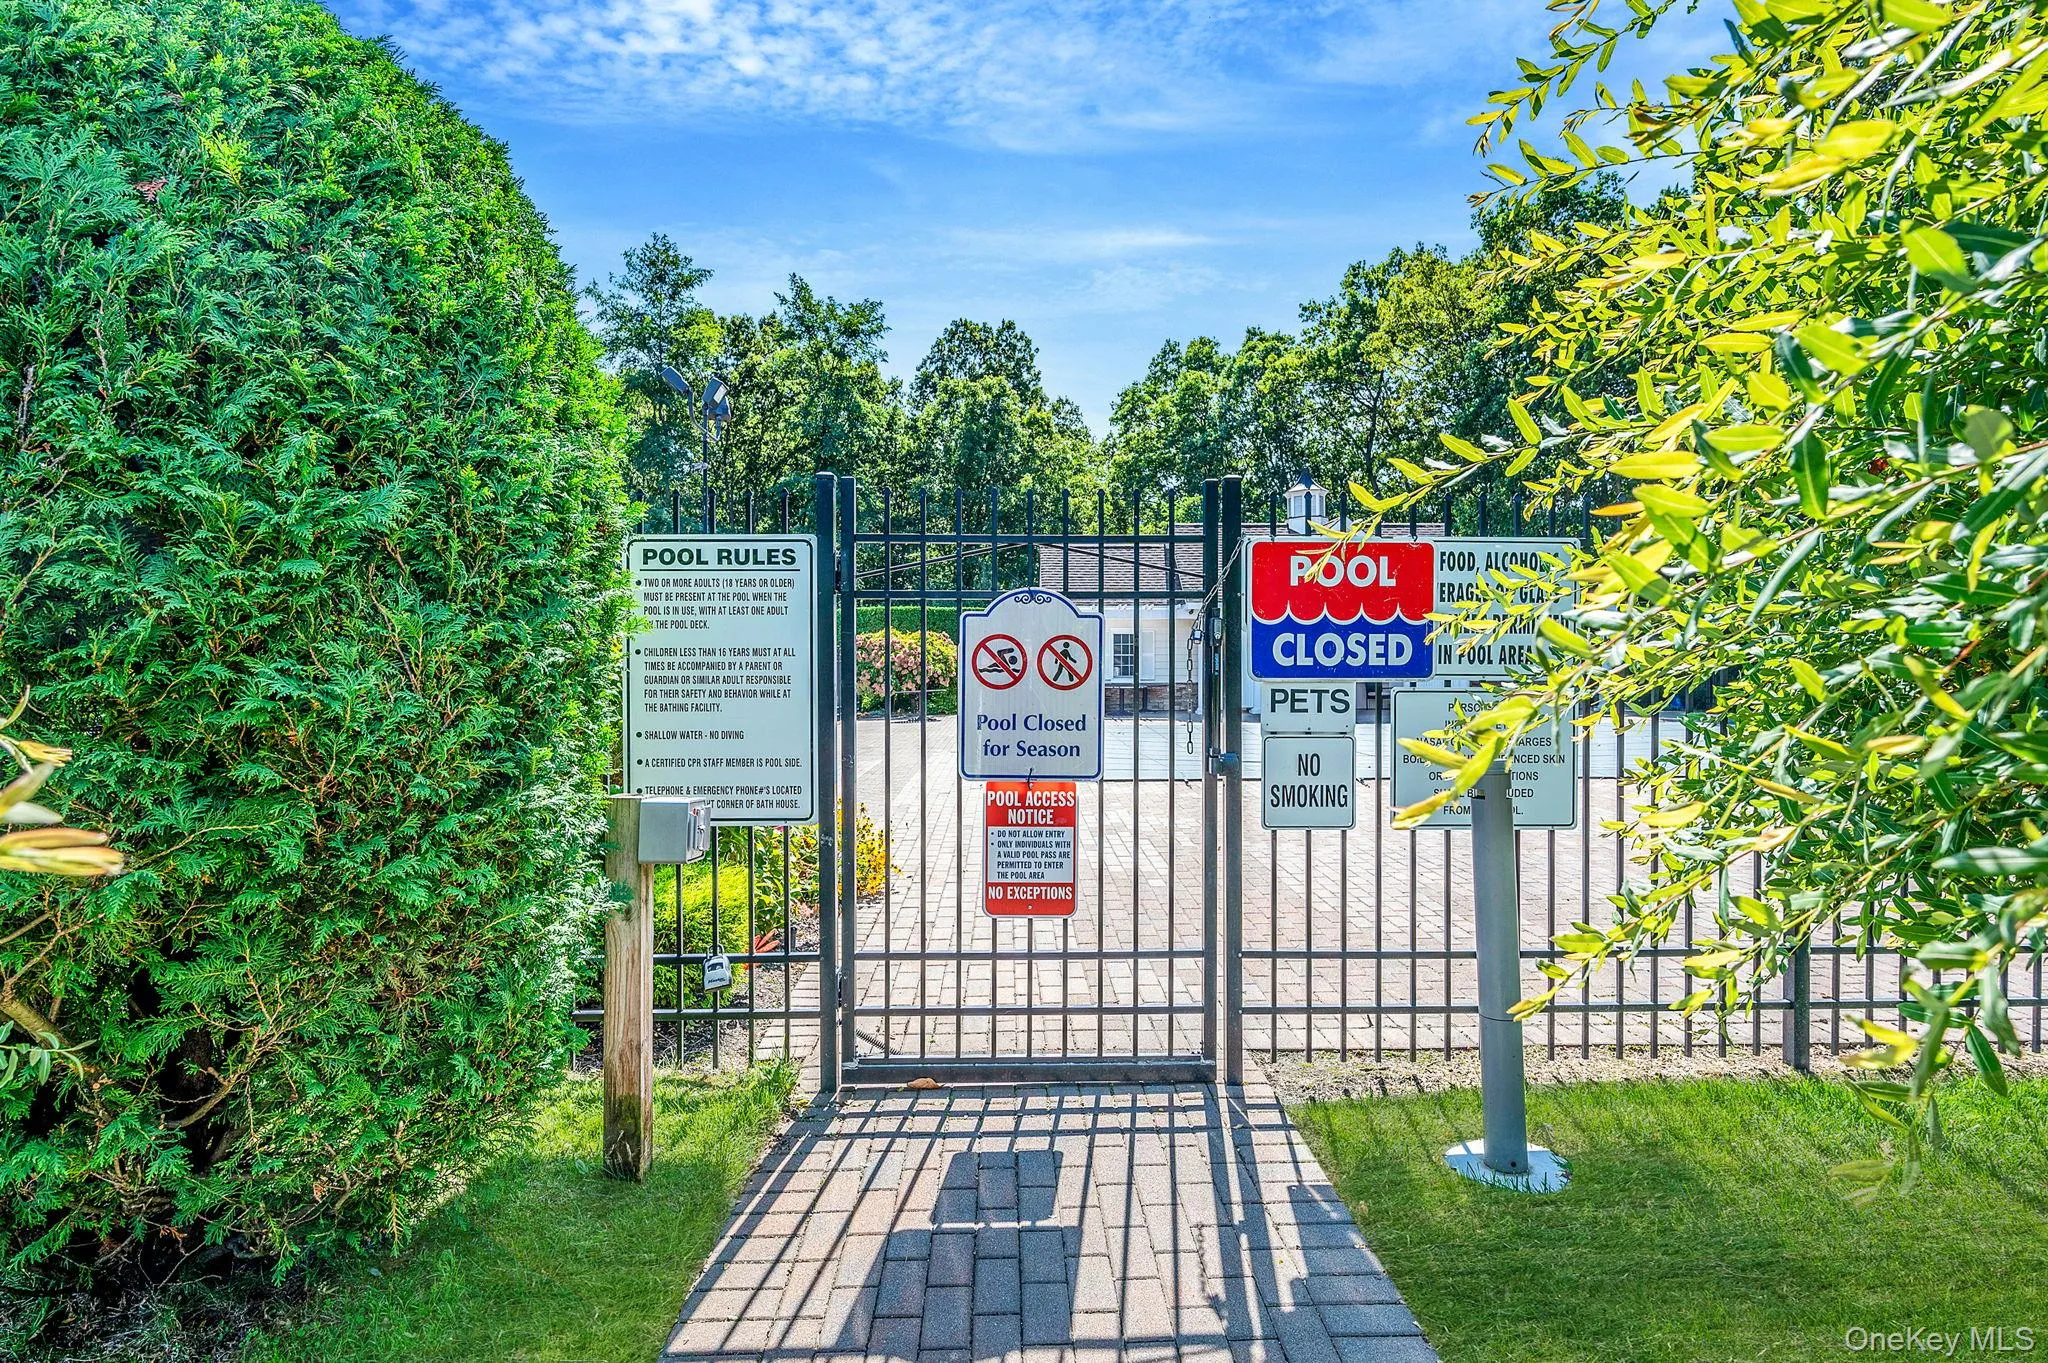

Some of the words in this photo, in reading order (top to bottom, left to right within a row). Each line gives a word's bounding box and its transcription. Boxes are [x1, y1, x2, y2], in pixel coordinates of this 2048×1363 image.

[642, 548, 709, 566] POOL
[717, 548, 796, 566] RULES
[1440, 551, 1480, 576] FOOD,
[1485, 552, 1560, 573] ALCOHOL
[1290, 555, 1397, 587] POOL
[644, 578, 660, 588] TWO
[661, 578, 671, 588] OR
[673, 578, 692, 588] MORE
[694, 578, 720, 588] ADULTS
[722, 578, 733, 589] (18
[735, 578, 757, 588] YEARS
[759, 578, 768, 588] OR
[770, 578, 795, 589] OLDER)
[644, 592, 662, 601] MUST
[664, 592, 673, 601] BE
[675, 592, 706, 601] PRESENT
[707, 592, 716, 601] AT
[717, 592, 731, 601] THE
[732, 592, 750, 601] POOL
[752, 592, 772, 601] WHEN
[774, 592, 787, 601] THE
[644, 606, 662, 615] POOL
[663, 606, 671, 615] IS
[672, 606, 680, 615] IN
[681, 606, 697, 617] USE,
[699, 606, 716, 615] WITH
[718, 606, 726, 615] AT
[728, 606, 749, 615] LEAST
[751, 606, 765, 615] ONE
[766, 606, 788, 615] ADULT
[655, 620, 668, 629] THE
[670, 620, 689, 629] POOL
[690, 620, 710, 629] DECK.
[644, 648, 678, 657] CHILDREN
[679, 648, 696, 657] LESS
[698, 648, 716, 657] THAN
[718, 648, 726, 657] 16
[728, 648, 750, 657] YEARS
[752, 648, 771, 657] MUST
[773, 648, 781, 657] AT
[783, 648, 796, 657] ALL
[1272, 632, 1413, 667] CLOSED
[1438, 645, 1452, 664] IN
[644, 662, 665, 671] TIMES
[667, 662, 676, 671] BE
[678, 662, 726, 671] ACCOMPANIED
[728, 662, 737, 671] BY
[738, 662, 743, 671] A
[745, 662, 771, 671] PARENT
[772, 662, 782, 671] OR
[644, 676, 679, 685] GUARDIAN
[681, 676, 691, 685] OR
[692, 676, 720, 685] SIMILAR
[722, 676, 744, 685] ADULT
[745, 676, 791, 685] RESPONSIBLE
[644, 689, 658, 698] FOR
[660, 689, 679, 698] THEIR
[681, 689, 706, 698] SAFETY
[708, 689, 722, 698] AND
[724, 689, 758, 698] BEHAVIOR
[759, 689, 781, 698] WHILE
[782, 689, 791, 698] AT
[1270, 688, 1350, 714] PETS
[644, 703, 658, 712] THE
[659, 703, 689, 712] BATHING
[690, 703, 722, 712] FACILITY.
[977, 713, 1016, 731] Pool
[1023, 713, 1086, 731] Closed
[644, 731, 678, 740] SHALLOW
[679, 731, 703, 740] WATER
[709, 731, 719, 740] NO
[721, 731, 744, 740] DIVING
[983, 739, 1009, 757] for
[1016, 739, 1080, 757] Season
[645, 758, 650, 767] A
[651, 758, 685, 767] CERTIFIED
[687, 758, 701, 767] CPR
[703, 758, 724, 767] STAFF
[725, 758, 755, 767] MEMBER
[756, 758, 763, 767] IS
[765, 758, 783, 767] POOL
[784, 758, 802, 767] SIDE.
[1297, 753, 1321, 777] NO
[645, 786, 683, 795] TELEPHONE
[685, 786, 691, 795] &
[693, 786, 734, 795] EMERGENCY
[772, 786, 802, 795] LOCATED
[1270, 784, 1348, 808] SMOKING
[716, 800, 743, 809] CORNER
[745, 800, 755, 809] OF
[756, 800, 773, 809] BATH
[775, 800, 800, 809] HOUSE.
[987, 791, 1021, 807] POOL
[1025, 791, 1075, 807] ACCESS
[1443, 805, 1471, 815] FROM
[1008, 809, 1054, 825] NOTICE
[997, 830, 1007, 838] DO
[1008, 830, 1021, 838] NOT
[1022, 830, 1043, 838] ALLOW
[1045, 830, 1065, 838] ENTRY
[997, 861, 1033, 869] PERMITTED
[1034, 861, 1042, 869] TO
[1044, 861, 1064, 869] ENTER
[988, 886, 1003, 900] NO
[1007, 886, 1073, 900] EXCEPTIONS
